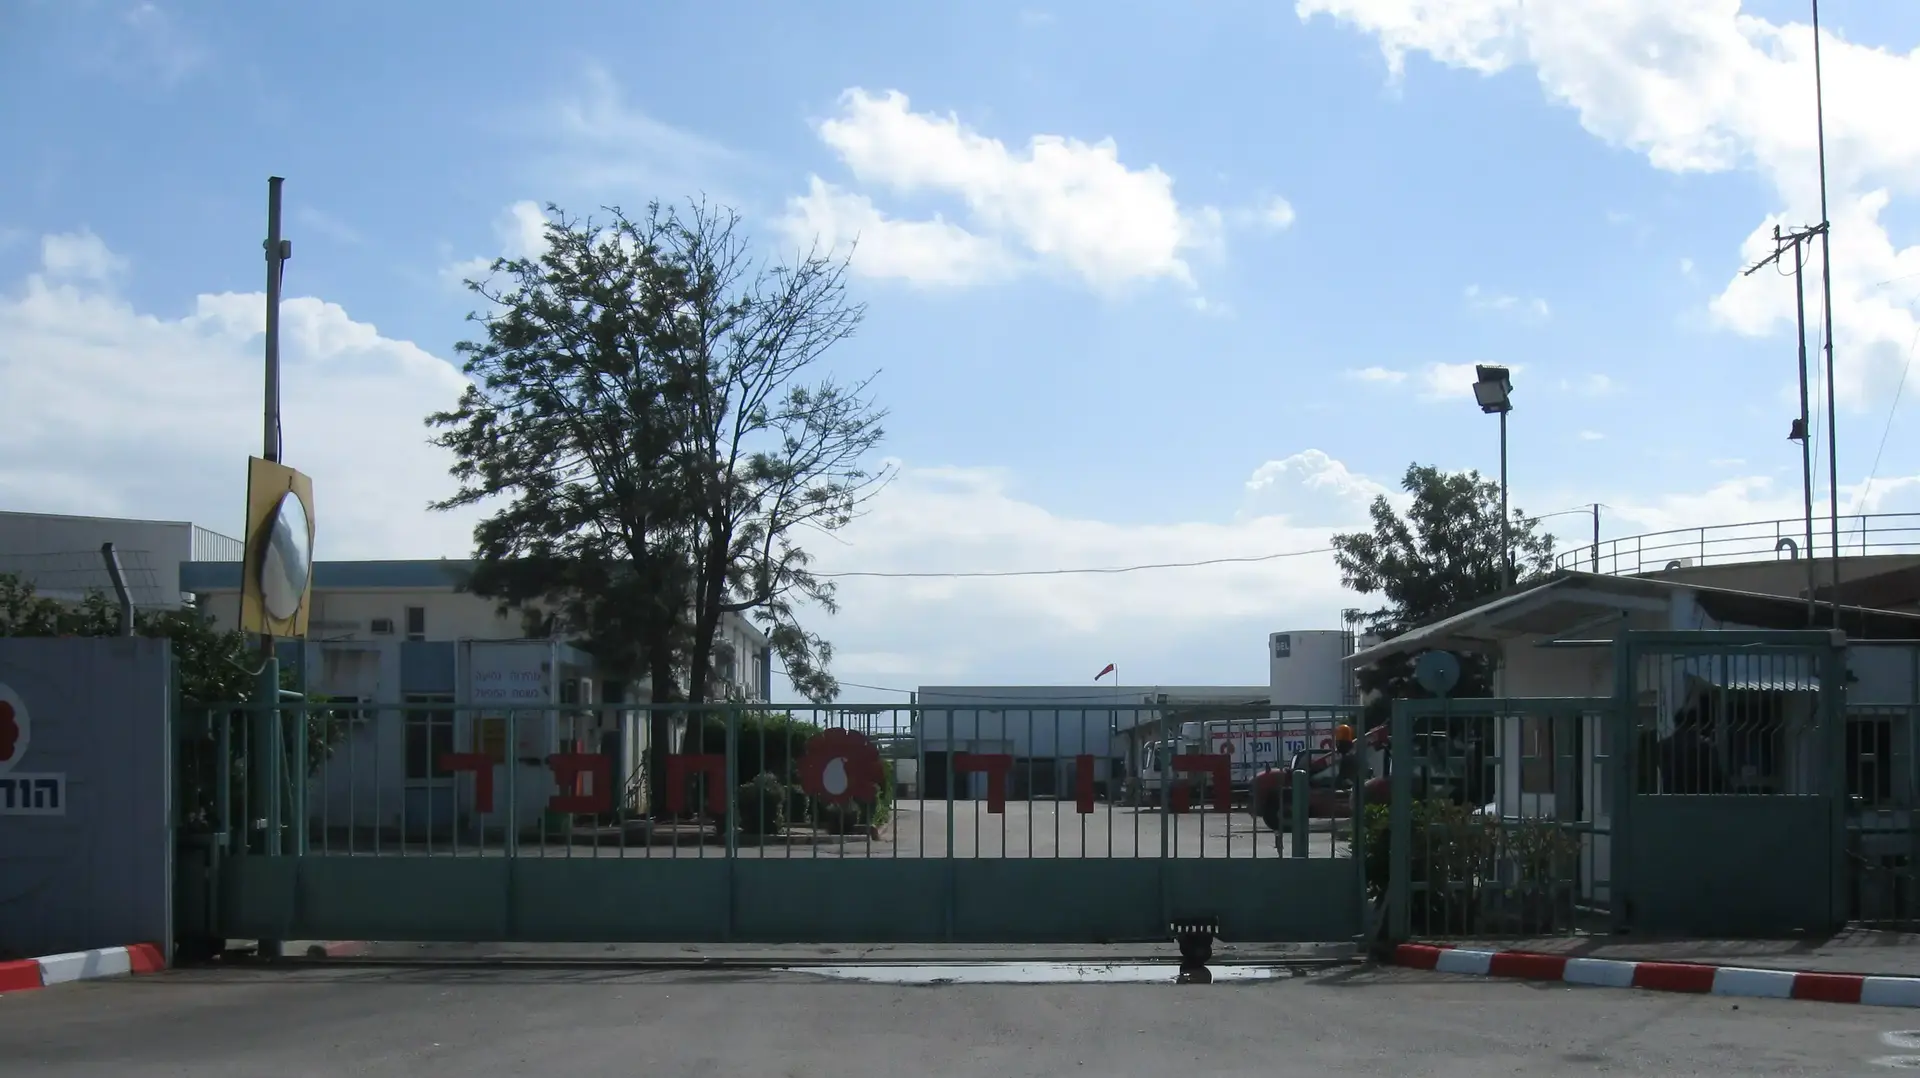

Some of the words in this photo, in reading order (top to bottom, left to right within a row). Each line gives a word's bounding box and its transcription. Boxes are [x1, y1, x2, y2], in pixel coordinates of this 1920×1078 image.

[1285, 740, 1304, 753] הוד
[439, 753, 727, 813] חפר
[953, 754, 1231, 813] הוד
